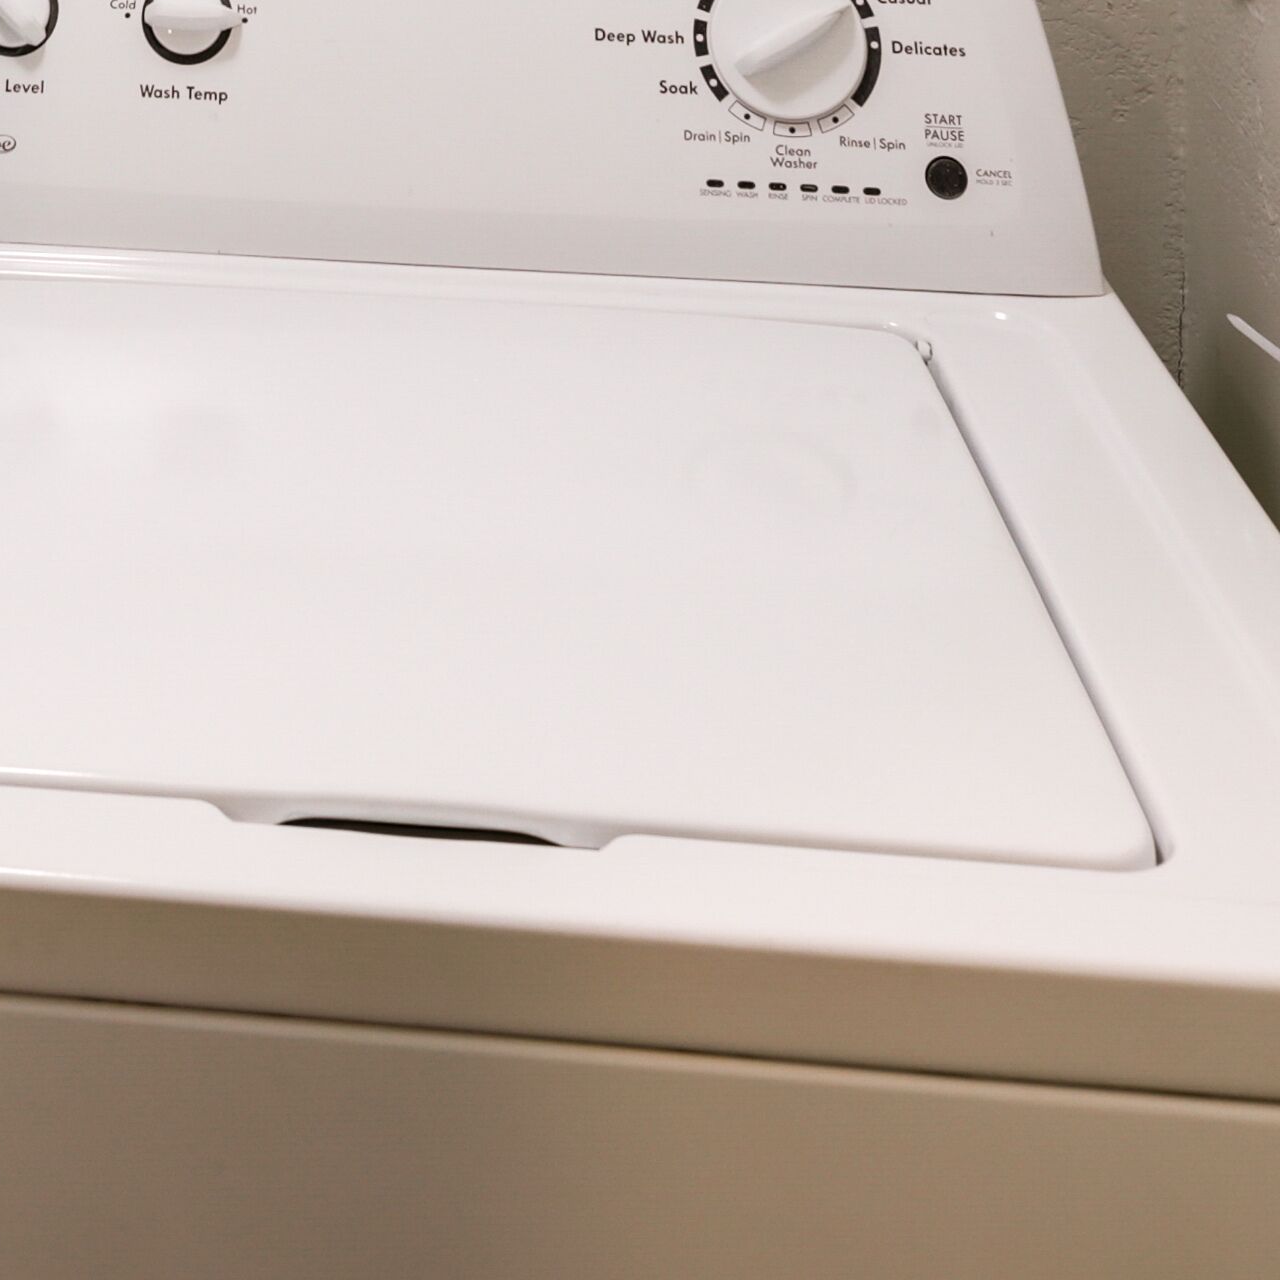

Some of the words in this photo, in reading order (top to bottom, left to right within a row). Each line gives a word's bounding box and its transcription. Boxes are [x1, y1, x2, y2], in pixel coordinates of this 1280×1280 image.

[237, 4, 258, 16] Hot
[594, 28, 636, 46] Deep
[641, 30, 685, 45] Wash
[891, 40, 967, 58] Delicates
[5, 79, 46, 95] Level
[659, 80, 698, 96] Soak
[140, 84, 181, 101] Wash
[186, 86, 229, 105] Temp
[924, 113, 962, 125] START
[683, 130, 717, 142] Drain
[724, 131, 751, 144] Spin
[925, 128, 964, 142] PAUSE
[840, 135, 871, 149] Rinse
[879, 138, 906, 151] Spin
[775, 144, 811, 157] Clean
[770, 157, 818, 170] Washer
[975, 168, 1012, 179] CANCEL
[699, 188, 732, 198] SENSING
[736, 190, 759, 199] WASH
[768, 192, 788, 200] RINSE
[801, 194, 818, 202] SPIN
[822, 195, 860, 204] COMPLETE
[864, 197, 876, 205] LID
[877, 197, 908, 206] LOCKED
